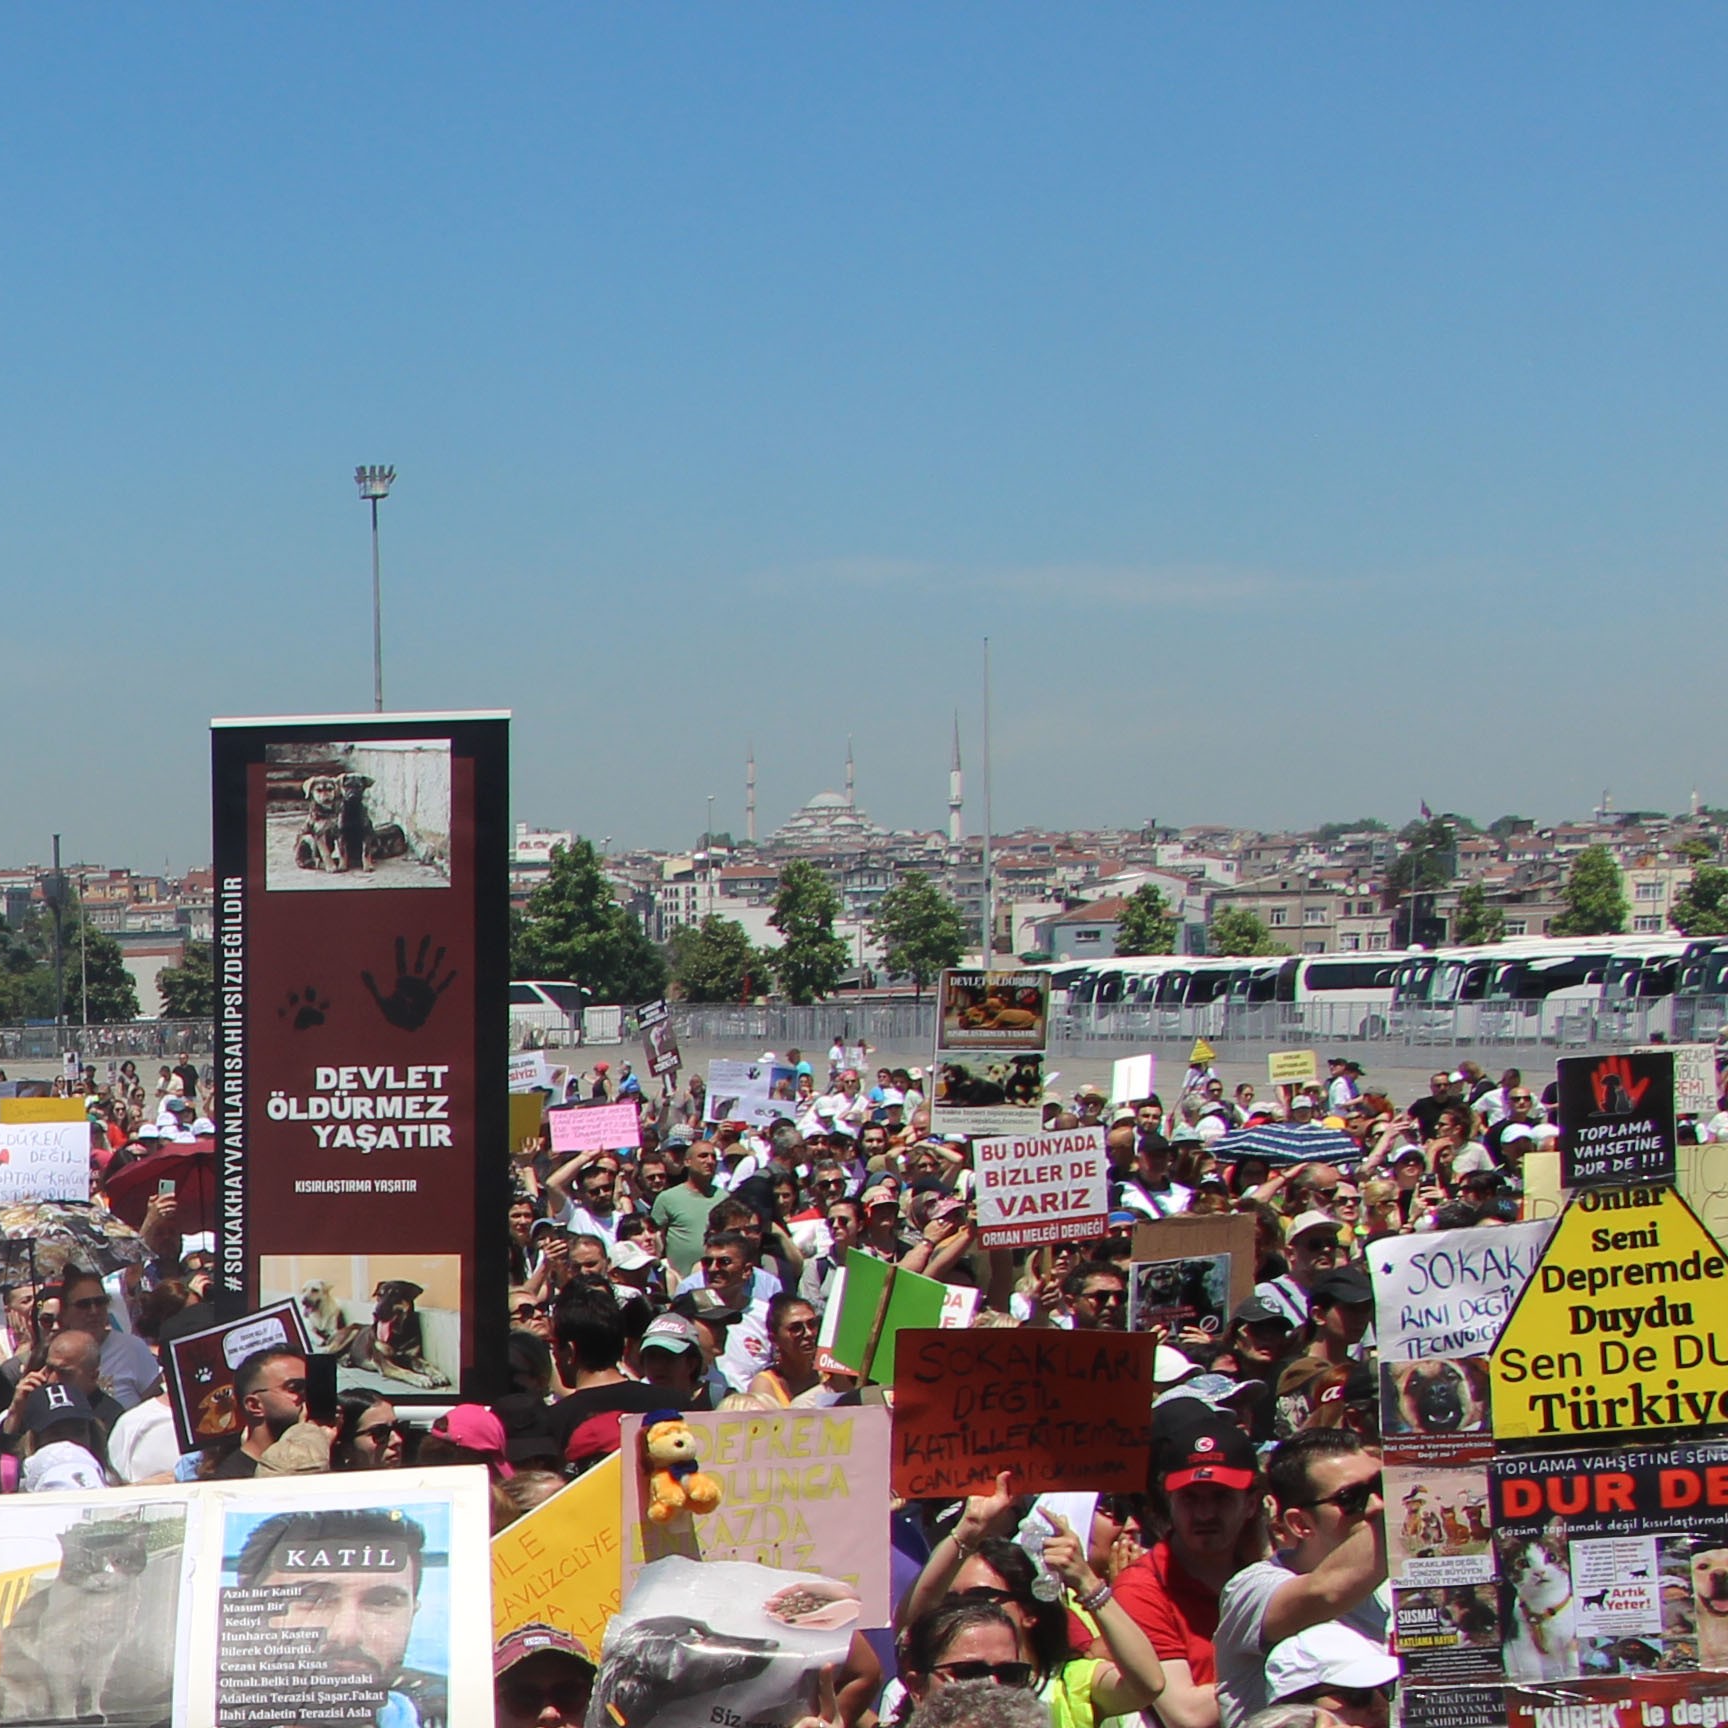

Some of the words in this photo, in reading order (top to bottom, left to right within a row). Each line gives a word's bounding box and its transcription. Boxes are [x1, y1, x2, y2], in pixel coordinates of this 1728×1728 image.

[221, 874, 244, 1292] #SOKAKHAYVANLARISAHİPSİZDEĞİLDİR
[314, 1066, 448, 1089] DEVLET
[267, 1091, 448, 1121] ÖLDÜRMEZ
[312, 1123, 453, 1154] YAŞATIR
[981, 1142, 1012, 1161] BU
[1014, 1134, 1097, 1159] DÜNYADA
[295, 1180, 371, 1194] KISIRLAŞTIRMA
[375, 1179, 417, 1194] YAŞATIR
[985, 1164, 1062, 1188] BİZLER
[1070, 1160, 1097, 1179] DE
[995, 1188, 1091, 1217] VARIZ
[983, 1231, 1021, 1245] ORMAN
[1023, 1226, 1059, 1242] MELEĞİ
[1062, 1221, 1103, 1239] DERNEĞİ
[1591, 1223, 1659, 1251] Seni
[1542, 1251, 1724, 1295] Depremde
[1569, 1297, 1694, 1336] Duydu
[1500, 1348, 1582, 1383] Sen
[1600, 1340, 1657, 1375] De
